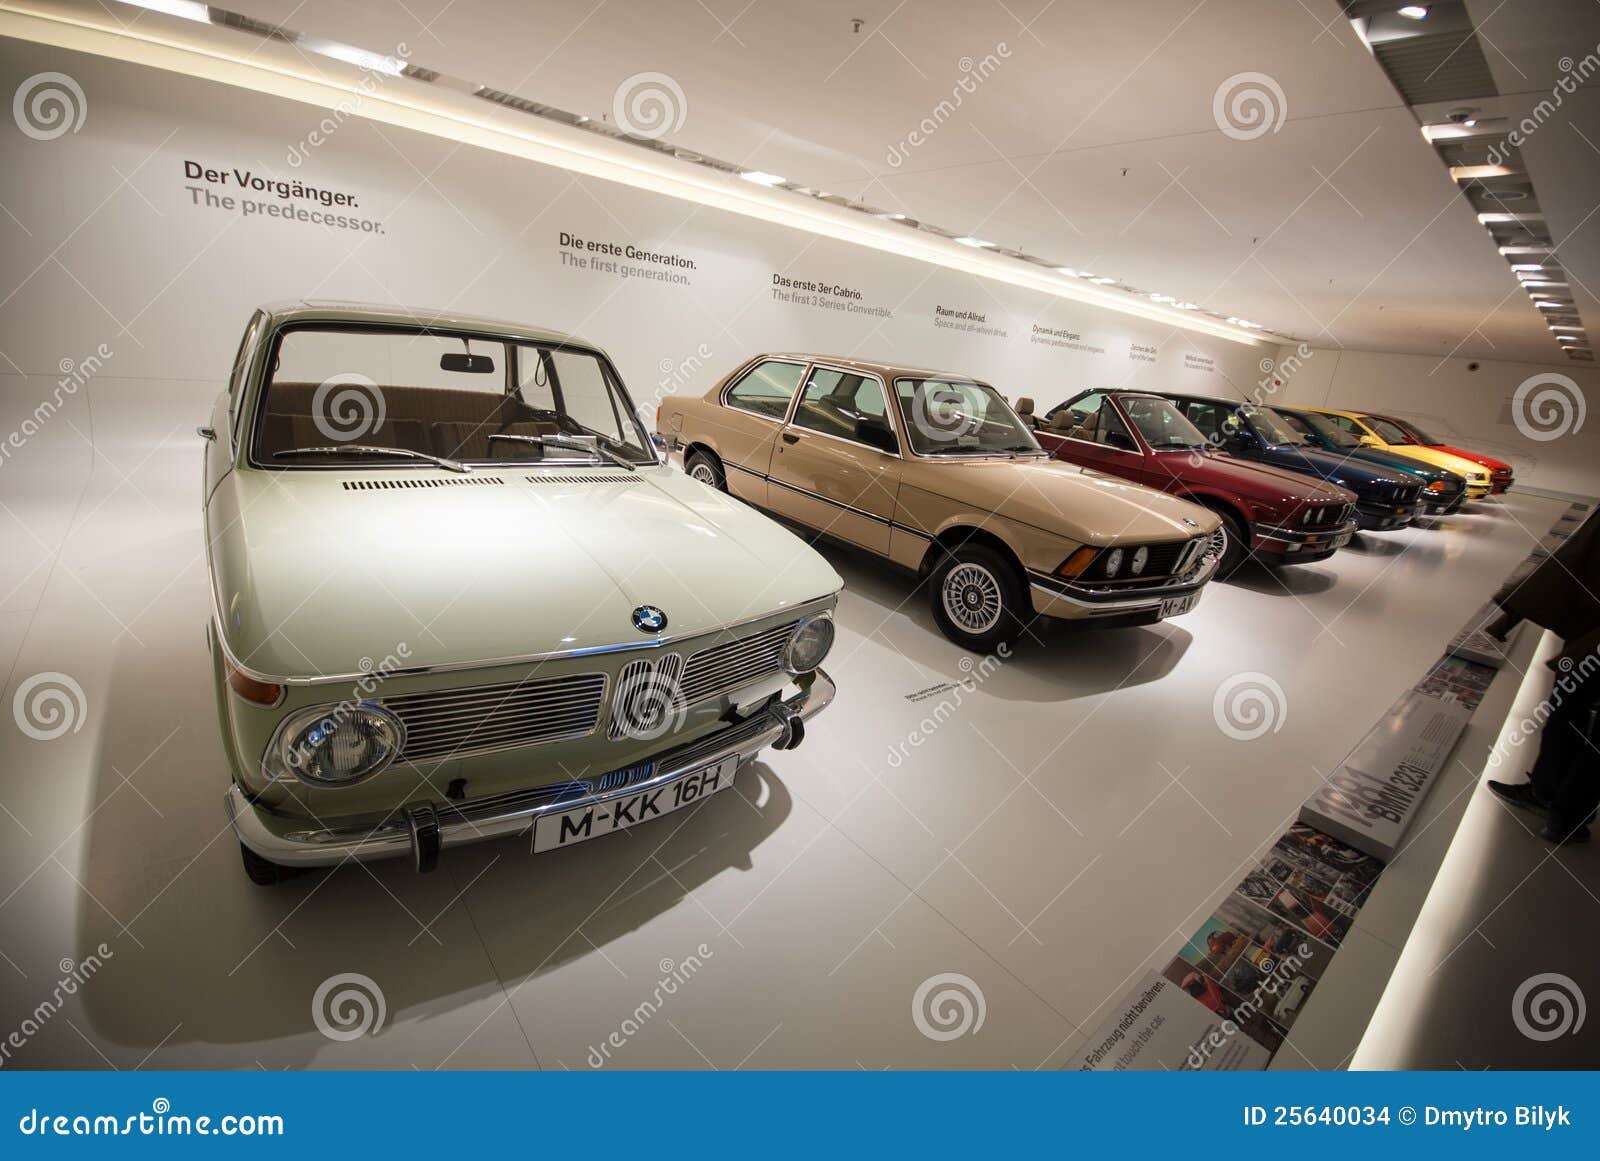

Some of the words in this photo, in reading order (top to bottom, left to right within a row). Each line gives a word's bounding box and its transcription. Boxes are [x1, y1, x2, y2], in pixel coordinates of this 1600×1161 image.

[184, 160, 230, 184] Der
[233, 169, 359, 208] Vorgänger.
[184, 186, 235, 209] The
[241, 200, 386, 234] predecessor.
[559, 231, 584, 249] Die
[586, 240, 622, 256] erste
[625, 245, 697, 270] Generation.
[559, 251, 587, 268] The
[590, 256, 617, 273] first
[620, 264, 691, 286] generation.
[772, 273, 791, 287] Das
[793, 279, 816, 292] erste
[817, 282, 832, 295] 3er
[833, 285, 863, 300] Cabrio.
[772, 288, 790, 302] The
[791, 292, 810, 305] first
[811, 296, 818, 306] 3
[819, 297, 846, 312] Series
[847, 302, 894, 318] Convertible.
[935, 305, 954, 317] Raum
[955, 311, 967, 320] und
[559, 789, 664, 843] M-KK
[672, 764, 722, 808] 16H
[1367, 780, 1415, 825] BMW
[1085, 1027, 1126, 1069] Fahrzeug
[1119, 1009, 1140, 1034] nicht
[1134, 980, 1166, 1013] berühren.
[1121, 1033, 1143, 1071] touch
[1139, 1023, 1155, 1045] the
